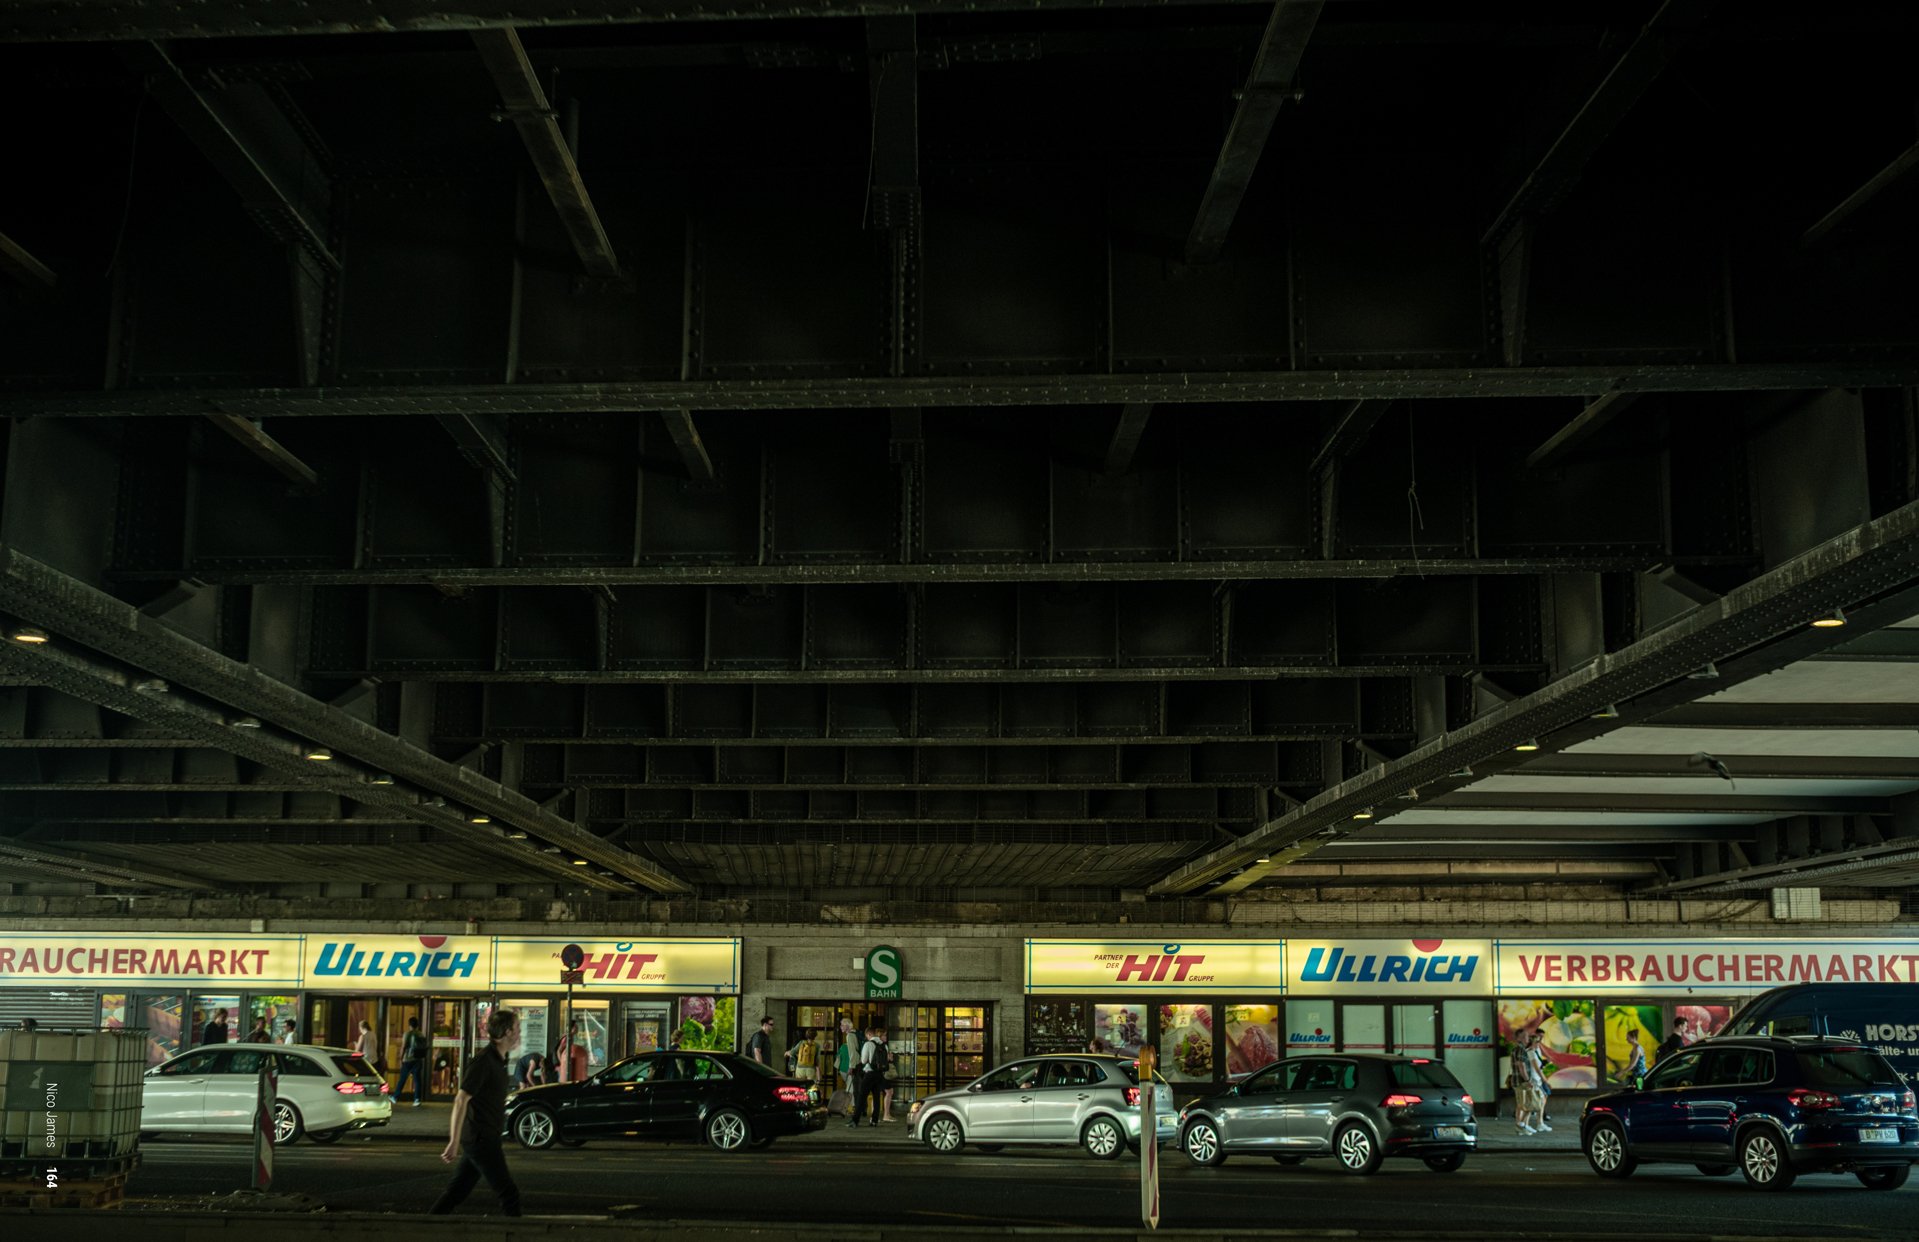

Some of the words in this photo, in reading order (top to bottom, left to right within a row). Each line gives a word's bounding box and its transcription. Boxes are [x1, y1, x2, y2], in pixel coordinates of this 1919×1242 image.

[0, 947, 269, 975] RAUCHERMARKT
[575, 953, 658, 980] HIT
[870, 949, 898, 989] S
[1115, 954, 1206, 982] HIT
[1300, 947, 1479, 983] ULLRICH
[1518, 954, 1919, 983] VERBRAUCHERMARKT
[641, 973, 666, 981] GRUPPE
[870, 989, 897, 998] BAHN
[1865, 1024, 1919, 1041] HORS
